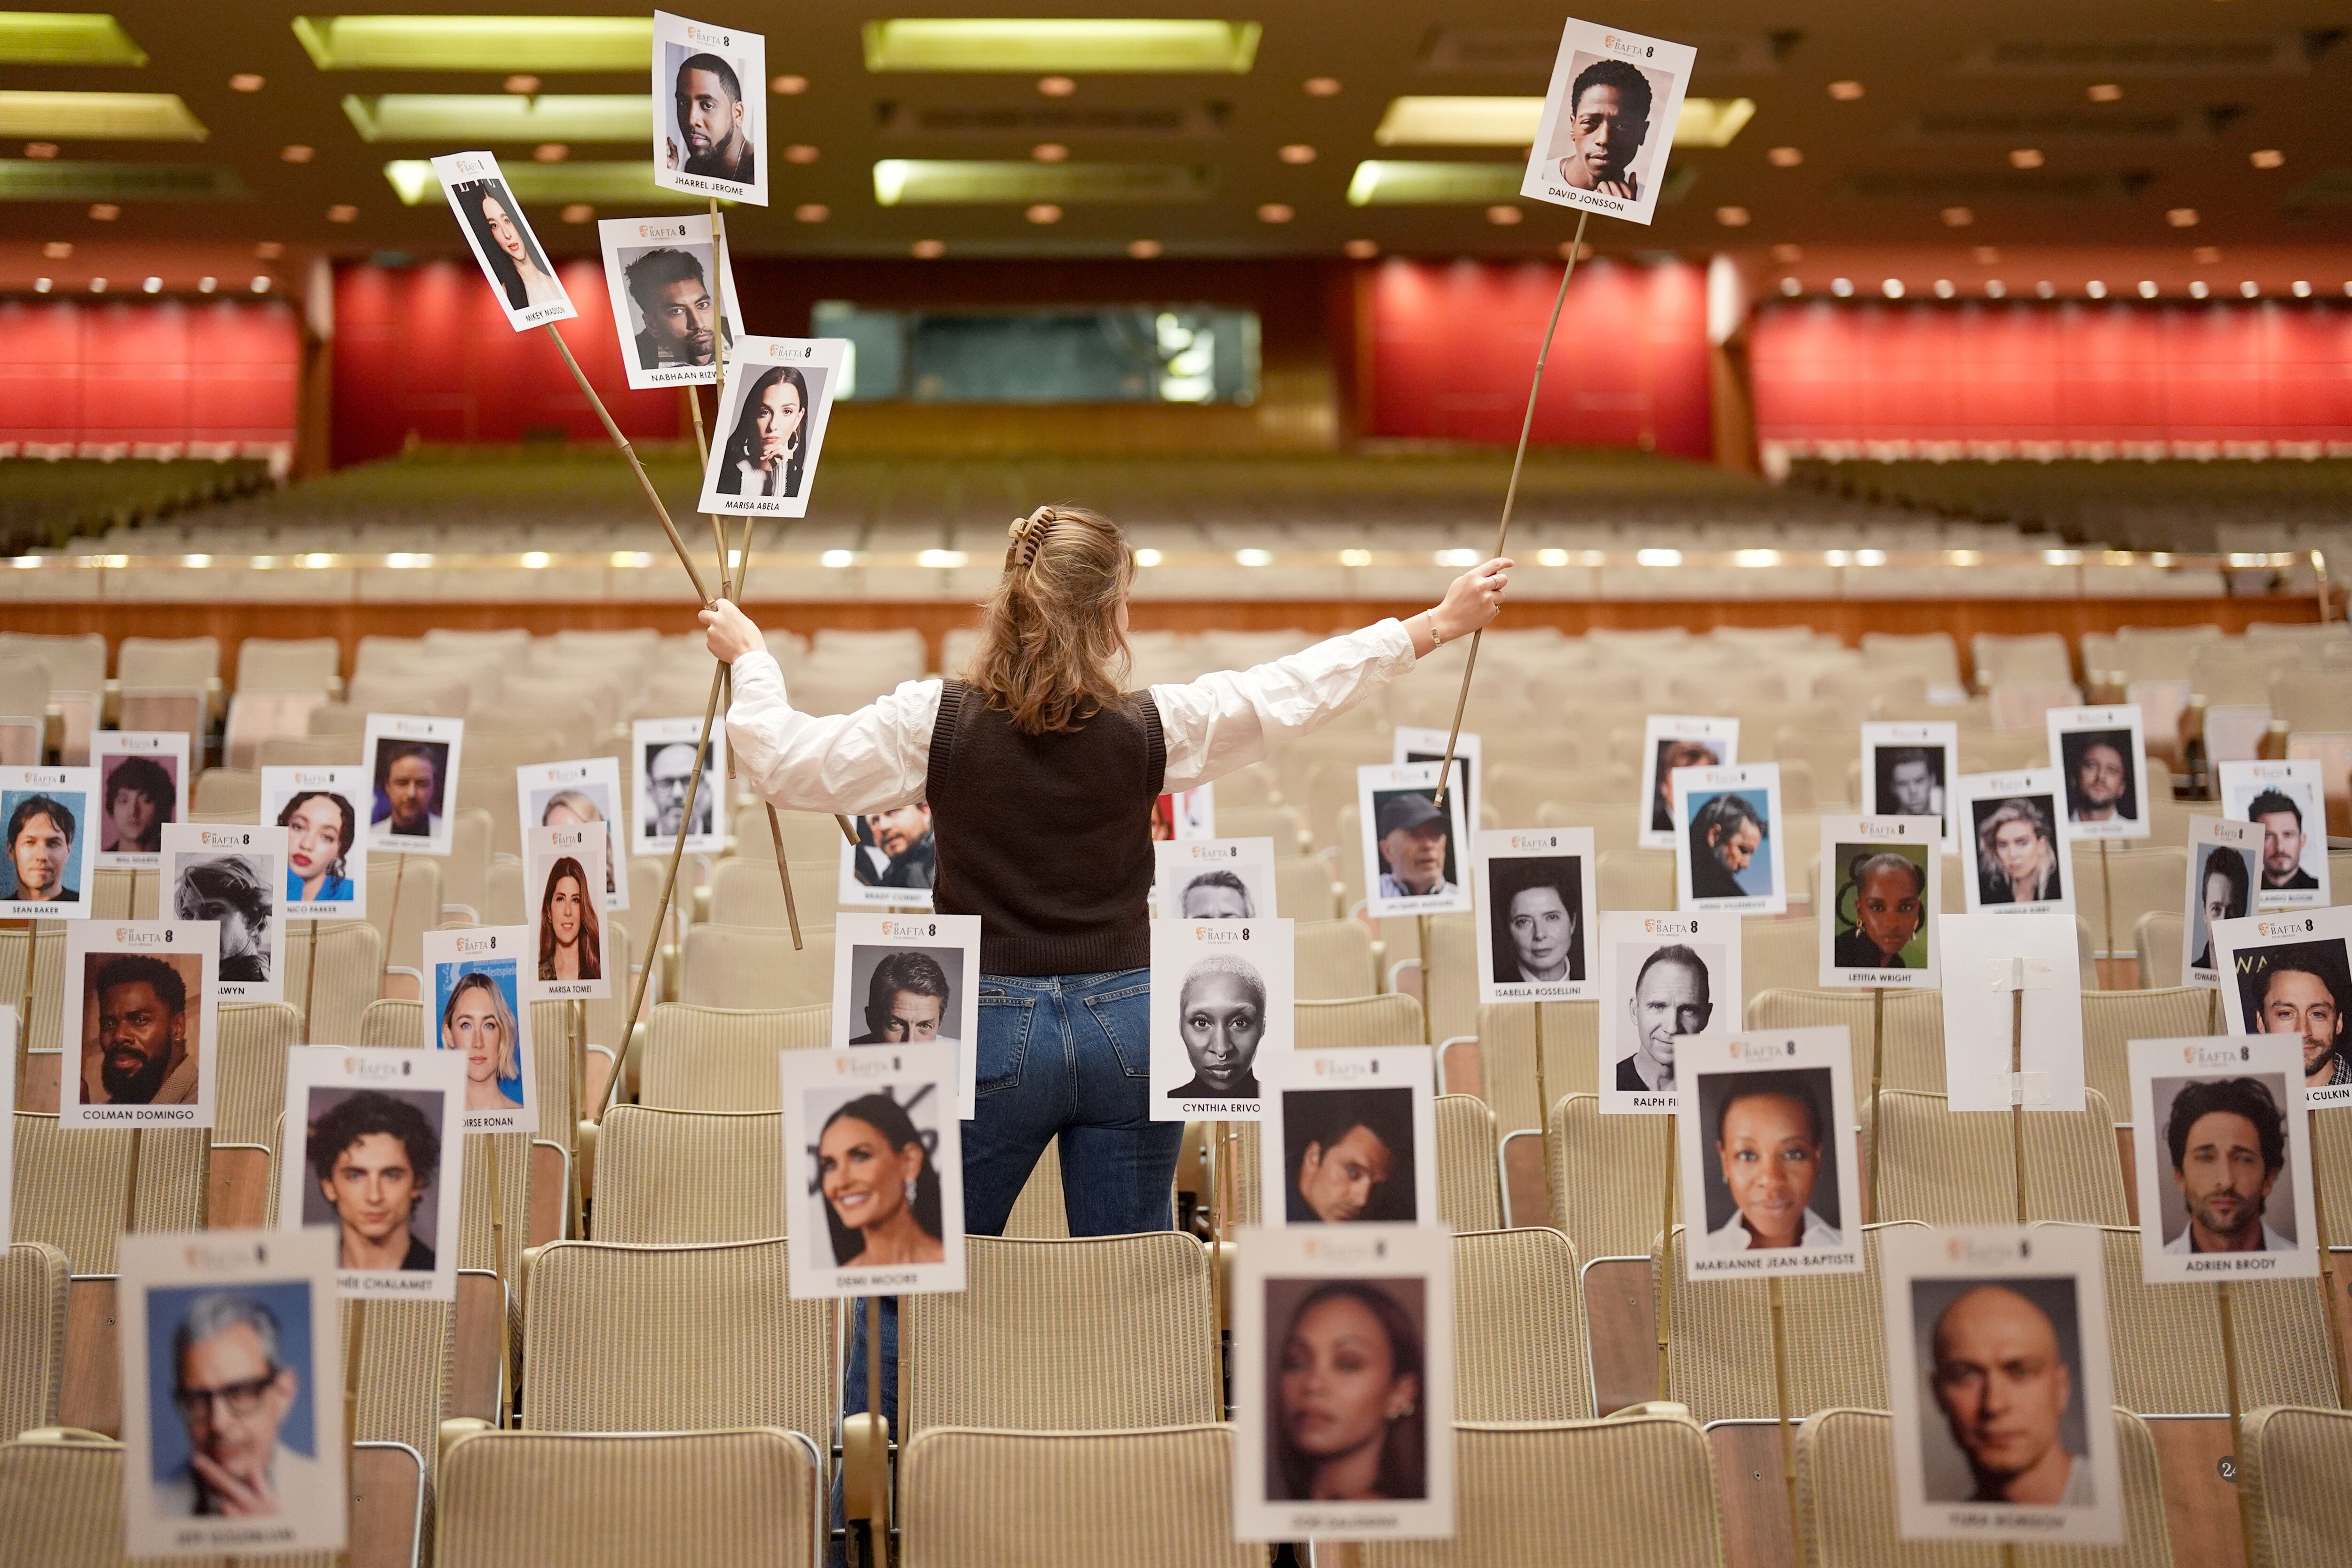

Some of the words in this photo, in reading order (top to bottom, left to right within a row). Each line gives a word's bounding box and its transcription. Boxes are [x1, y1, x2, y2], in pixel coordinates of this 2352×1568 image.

[697, 33, 721, 45] BAFTA
[1614, 42, 1642, 55] BAFTA
[675, 177, 708, 189] JHARREL
[711, 183, 743, 195] JEROME
[1549, 187, 1576, 200] DAVID
[1579, 195, 1623, 211] JONSSON
[525, 311, 543, 322] MIKEY
[544, 306, 565, 317] MADISON
[652, 372, 696, 382] NABHAAN
[725, 501, 754, 509] MARISA
[894, 927, 924, 936] BAFTA
[1657, 924, 1687, 933] BAFTA
[2271, 925, 2302, 934] BAFTA
[128, 934, 161, 942] BAFTA
[465, 942, 488, 950] BAFTA
[1849, 974, 1876, 982] LETITIA
[2194, 972, 2217, 982] EDWARD
[1496, 988, 1533, 997] ISABELLA
[1536, 987, 1581, 995] ROSSELLINI
[2312, 1090, 2350, 1100] CULKIN
[1634, 1098, 1664, 1106] RALPH
[83, 1111, 132, 1119] COLMAN
[137, 1111, 193, 1119] DOMINGO
[484, 1117, 513, 1126] RONAN
[1696, 1258, 1762, 1271] MARIANNE
[1767, 1253, 1856, 1268] JEAN-BAPTISTE
[2186, 1260, 2231, 1271] ADRIEN
[2235, 1258, 2276, 1269] BRODY
